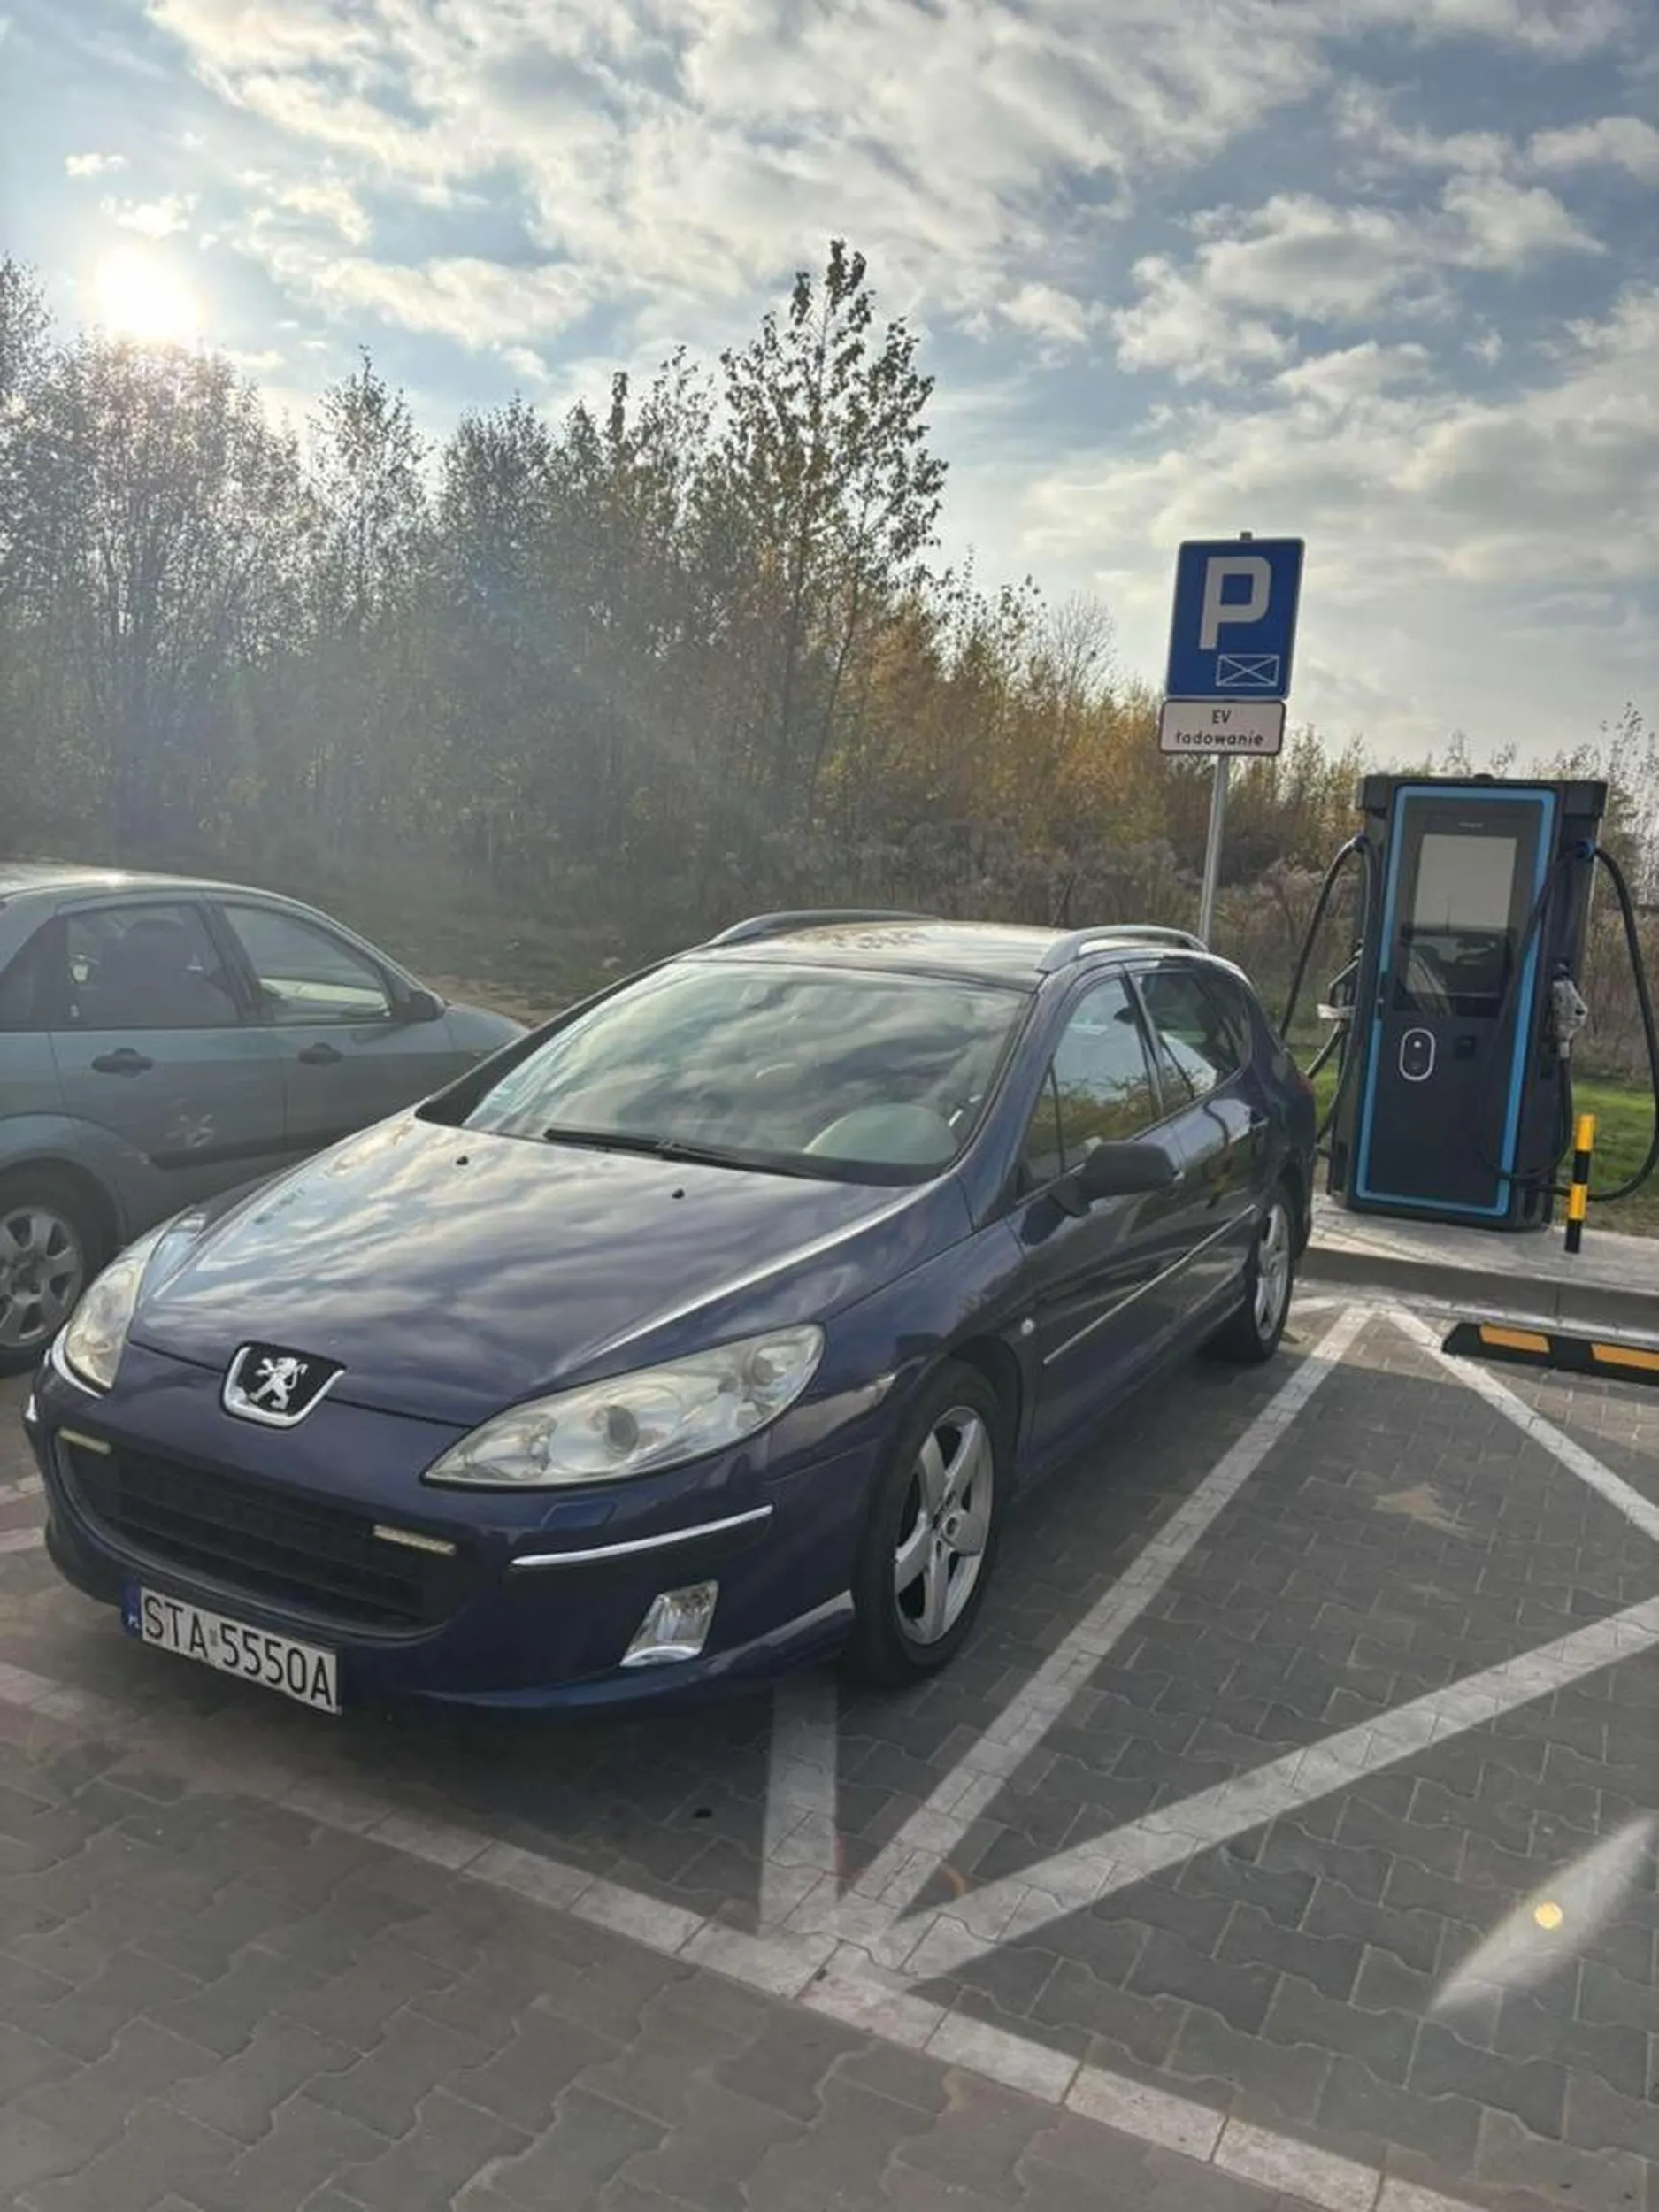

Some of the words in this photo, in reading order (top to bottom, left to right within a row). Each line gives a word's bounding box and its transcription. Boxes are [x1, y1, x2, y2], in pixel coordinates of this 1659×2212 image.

[1199, 556, 1271, 649] P
[1211, 709, 1232, 724] EV
[144, 1595, 208, 1658] STA
[219, 1621, 332, 1706] 5550A
